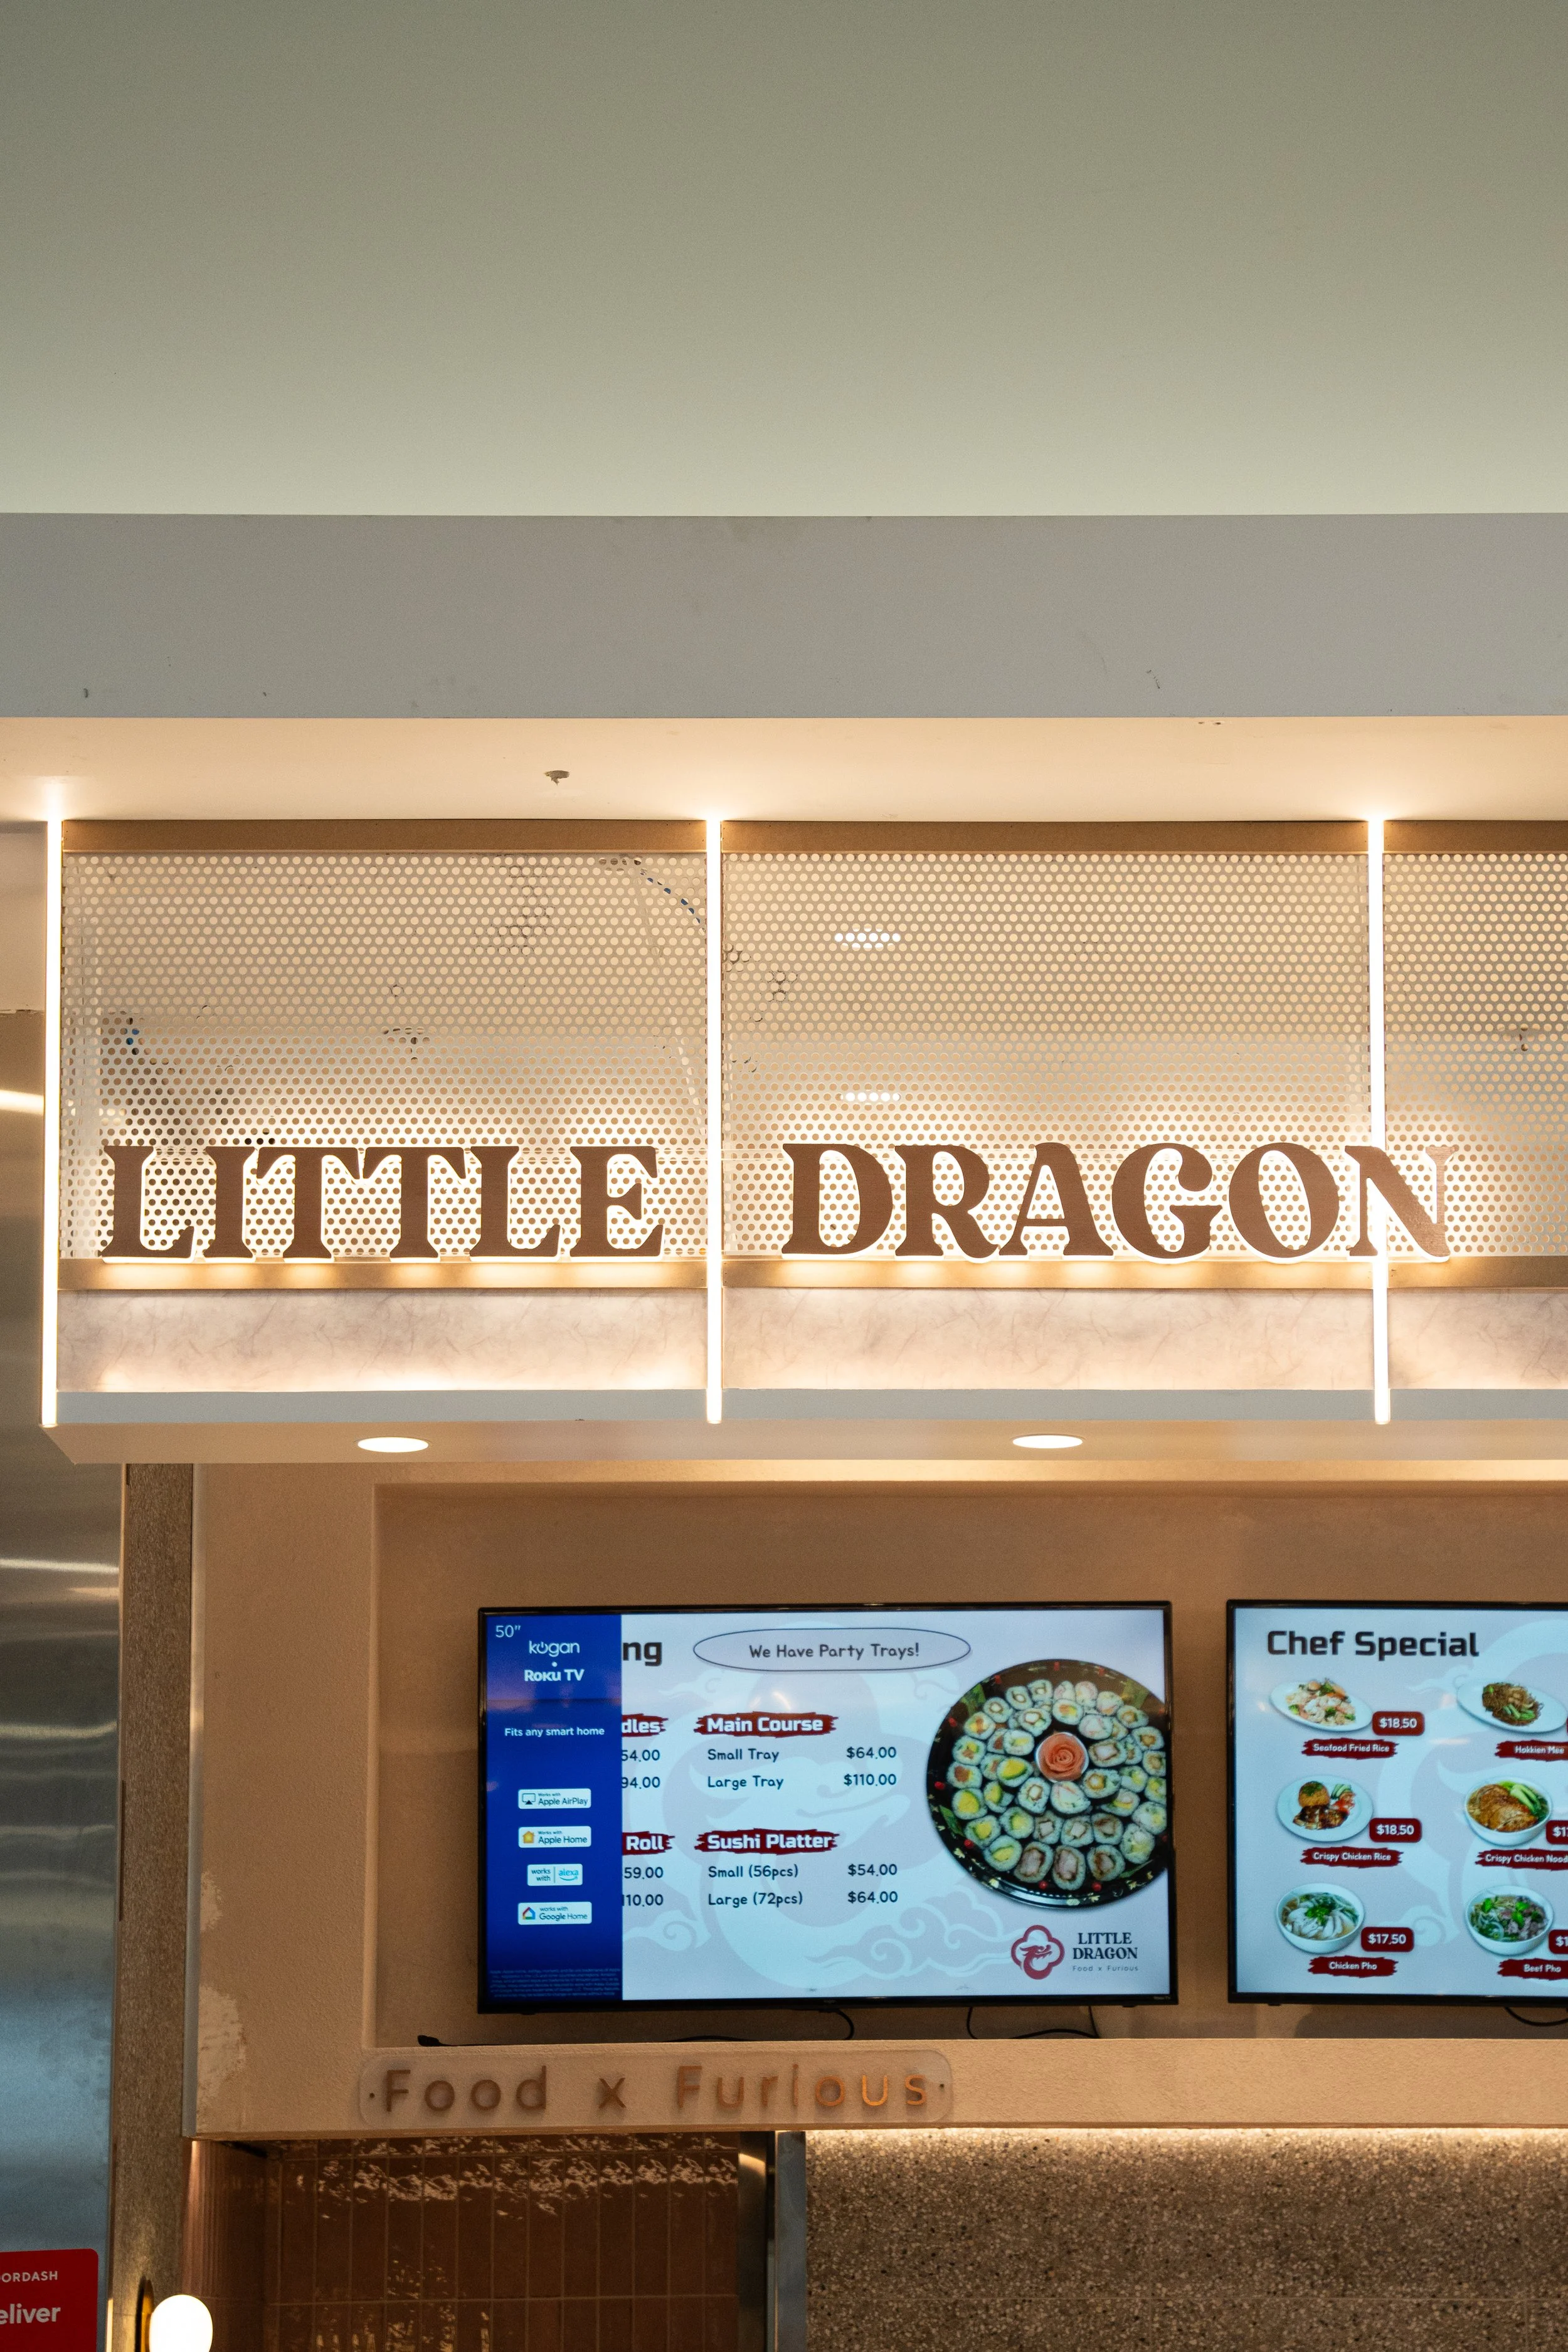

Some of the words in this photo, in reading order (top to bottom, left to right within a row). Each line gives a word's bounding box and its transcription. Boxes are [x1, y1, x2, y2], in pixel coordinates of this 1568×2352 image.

[102, 1145, 663, 1259] LITTLE
[781, 1142, 1454, 1261] DRAGON
[529, 1640, 580, 1657] kogan
[750, 1645, 771, 1658] We
[776, 1645, 813, 1658] Have
[819, 1644, 864, 1660] Party
[871, 1643, 919, 1661] Trays!
[1268, 1631, 1345, 1656] Chef
[1355, 1632, 1479, 1661] Special
[623, 1642, 662, 1666] ng
[524, 1670, 561, 1682] Roku
[564, 1669, 585, 1681] TV
[622, 1719, 661, 1733] dles
[707, 1718, 753, 1732] Main
[758, 1717, 824, 1732] Course
[504, 1727, 524, 1737] Fits
[526, 1727, 544, 1738] any
[546, 1727, 574, 1737] smart
[576, 1725, 605, 1736] home
[707, 1749, 743, 1761] Small
[748, 1749, 780, 1762] Tray
[847, 1747, 897, 1759] $64.00
[1313, 1744, 1348, 1752] Seafood
[1348, 1744, 1370, 1752] Fried
[1515, 1745, 1546, 1754] Hokkien
[1548, 1746, 1565, 1754] Mee
[707, 1776, 746, 1791] Large
[752, 1776, 784, 1789] Tray
[844, 1774, 897, 1786] $110.00
[538, 1798, 560, 1806] Apple
[562, 1797, 588, 1806] AirPlay
[1552, 1826, 1568, 1837] $1
[538, 1836, 561, 1845] Apple
[627, 1835, 664, 1850] Roll
[707, 1835, 761, 1850] Sushi
[766, 1833, 832, 1848] Platter
[1313, 1852, 1339, 1862] Crispy
[1342, 1852, 1372, 1860] Chicken
[1485, 1854, 1512, 1864] Crispy
[624, 1867, 664, 1880] 59.00
[708, 1865, 743, 1878] Small
[749, 1864, 798, 1880] (56pcs)
[848, 1863, 898, 1877] $54.00
[708, 1893, 748, 1907] Large
[753, 1891, 803, 1907] (72pcs)
[848, 1890, 898, 1904] $64.00
[539, 1912, 566, 1922] Google
[1078, 1932, 1132, 1944] LITTLE
[1073, 1947, 1138, 1959] DRAGON
[1328, 1961, 1359, 1970] Chicken
[1361, 1962, 1377, 1970] Pho
[1523, 1964, 1543, 1973] Beef
[1545, 1964, 1562, 1973] Pho
[384, 2065, 547, 2114] Food
[598, 2077, 626, 2108] x
[677, 2063, 926, 2108] Furious
[0, 2270, 58, 2282] ORDASH
